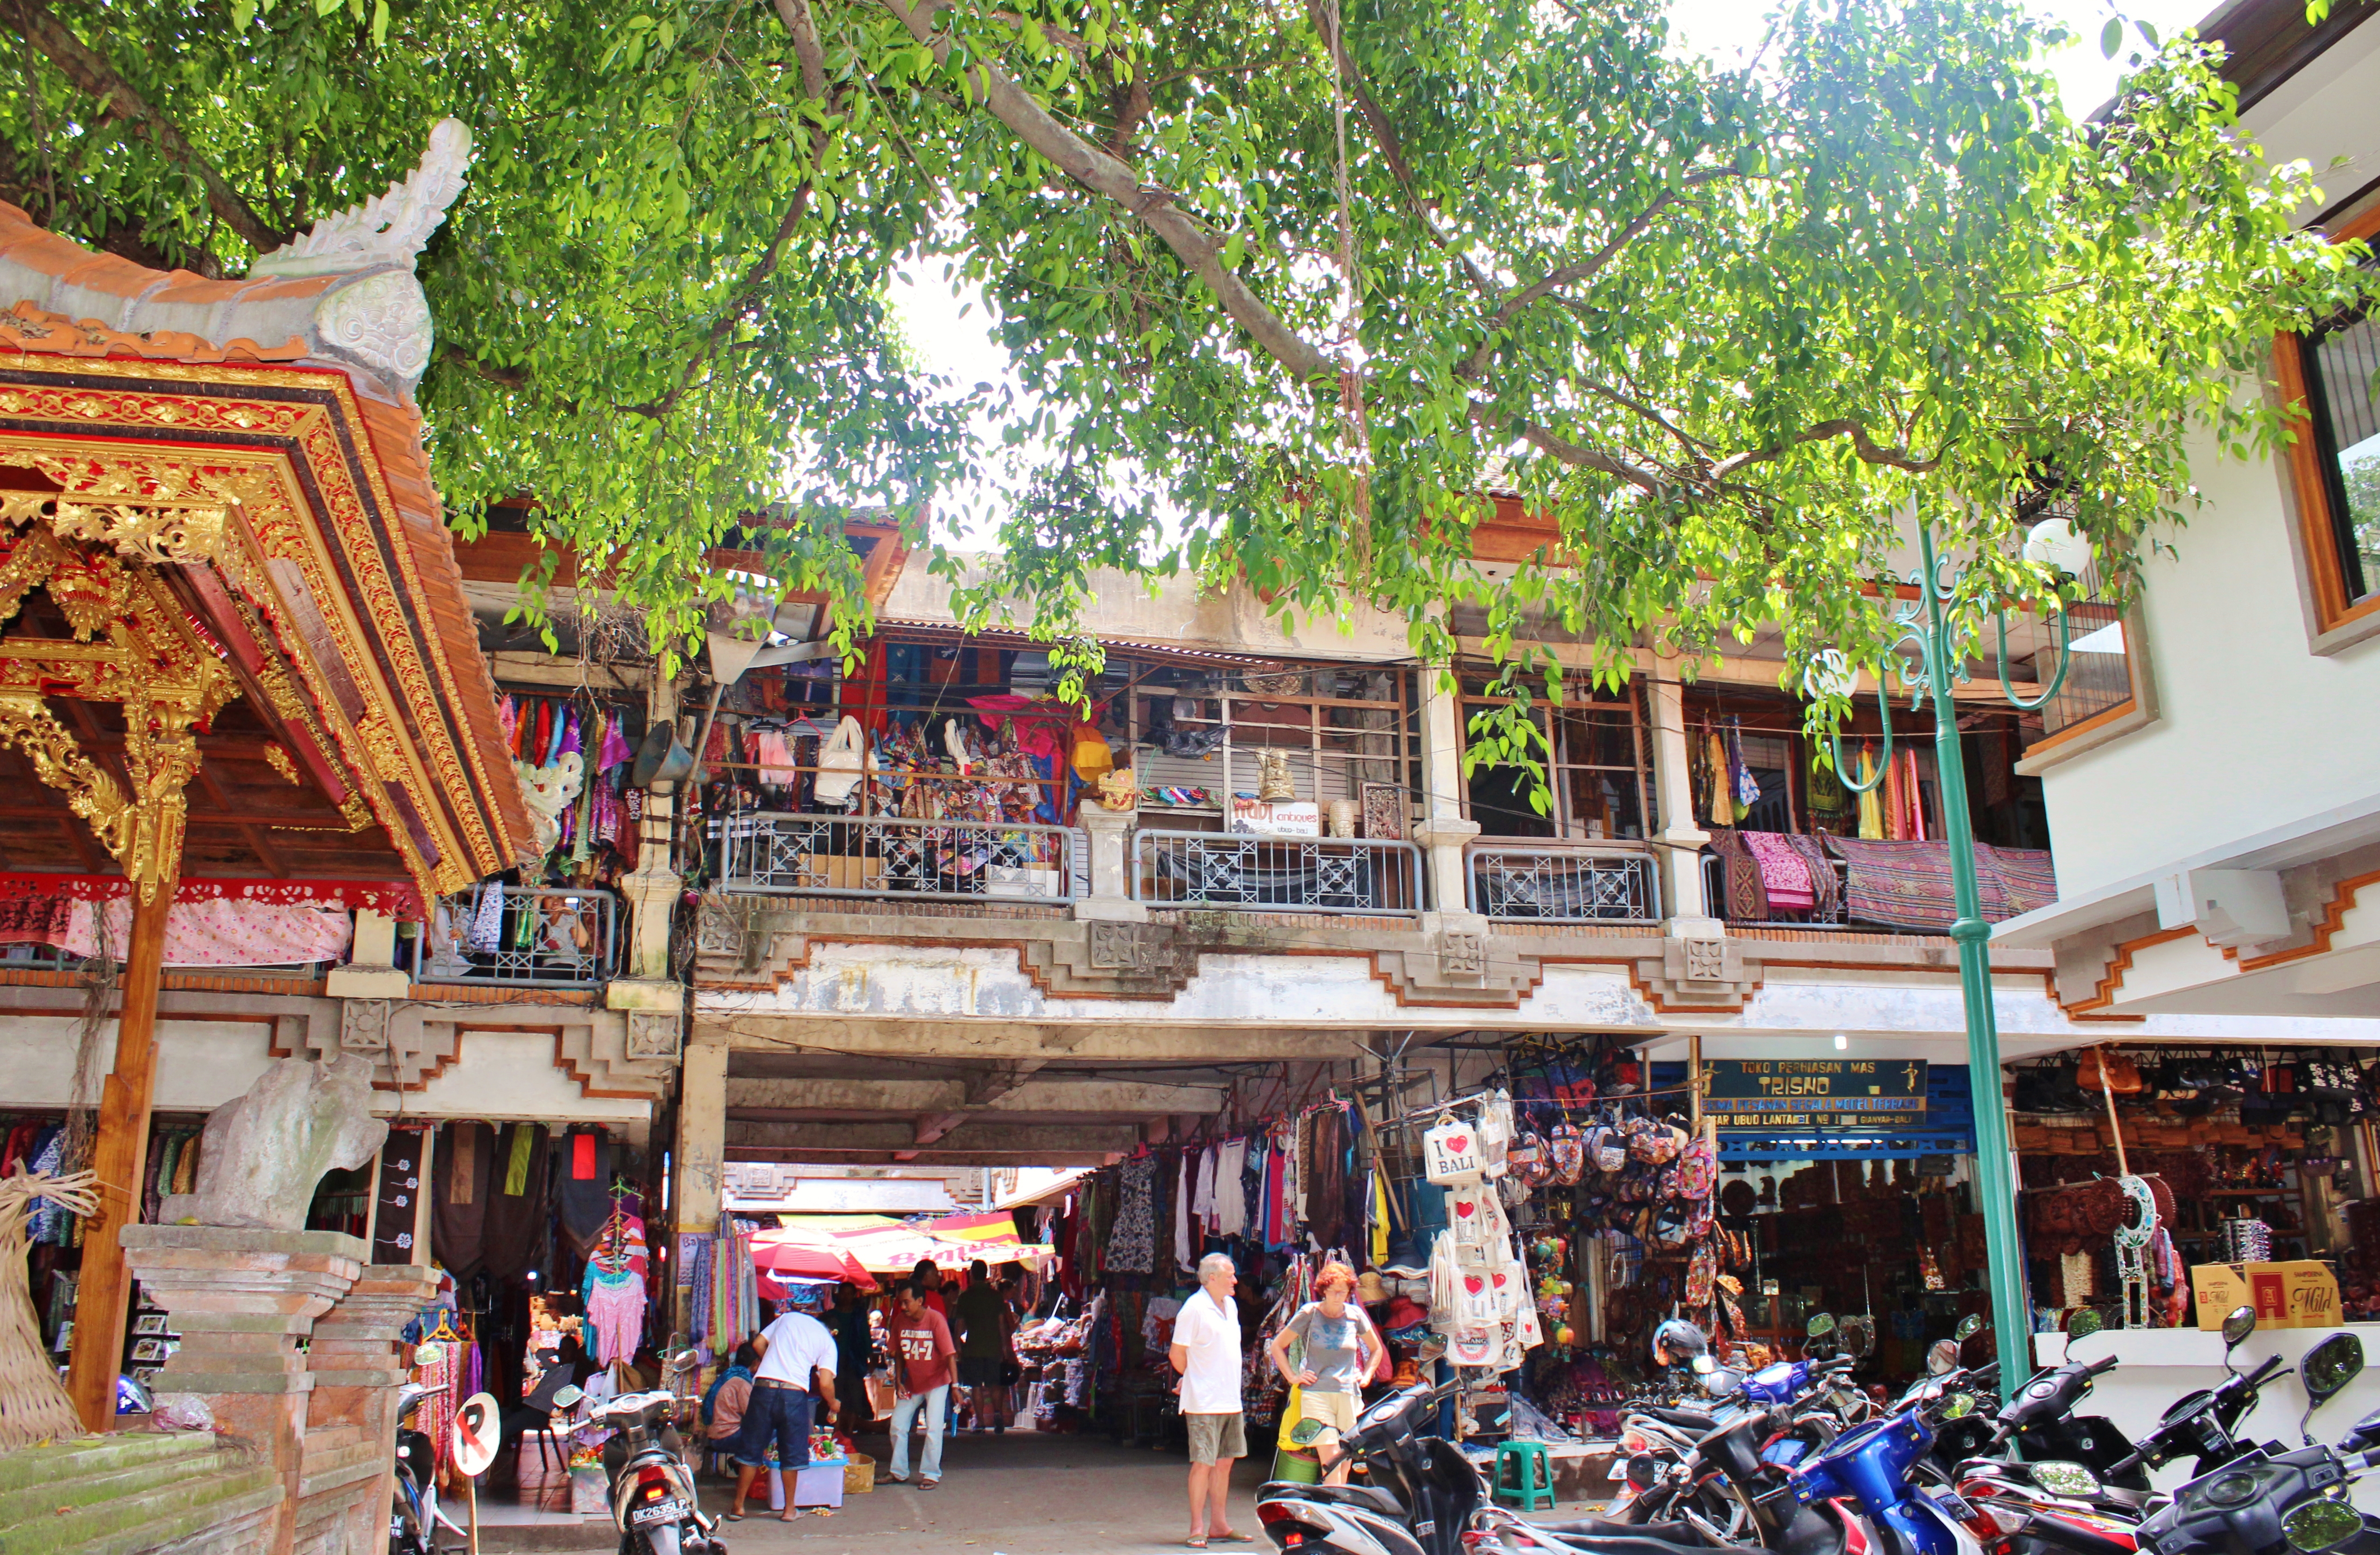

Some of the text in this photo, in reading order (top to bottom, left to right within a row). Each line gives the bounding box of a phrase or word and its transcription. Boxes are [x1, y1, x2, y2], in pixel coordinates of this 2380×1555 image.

[1277, 812, 1317, 823] antiques
[1741, 1062, 1876, 1073] TOKO PERHIASAN MAS
[1702, 1100, 1733, 1111] ERIMA
[1737, 1099, 1787, 1111] PESANAN
[1790, 1099, 1832, 1111] SEGALA
[1835, 1098, 1869, 1110] MODEL
[1733, 1114, 1759, 1125] UBUD
[1434, 1139, 1444, 1158] I
[1438, 1156, 1475, 1174] BALI
[2291, 1287, 2332, 1313] Mild
[900, 1330, 933, 1339] CALIFORNIA
[900, 1339, 933, 1361] 24-7
